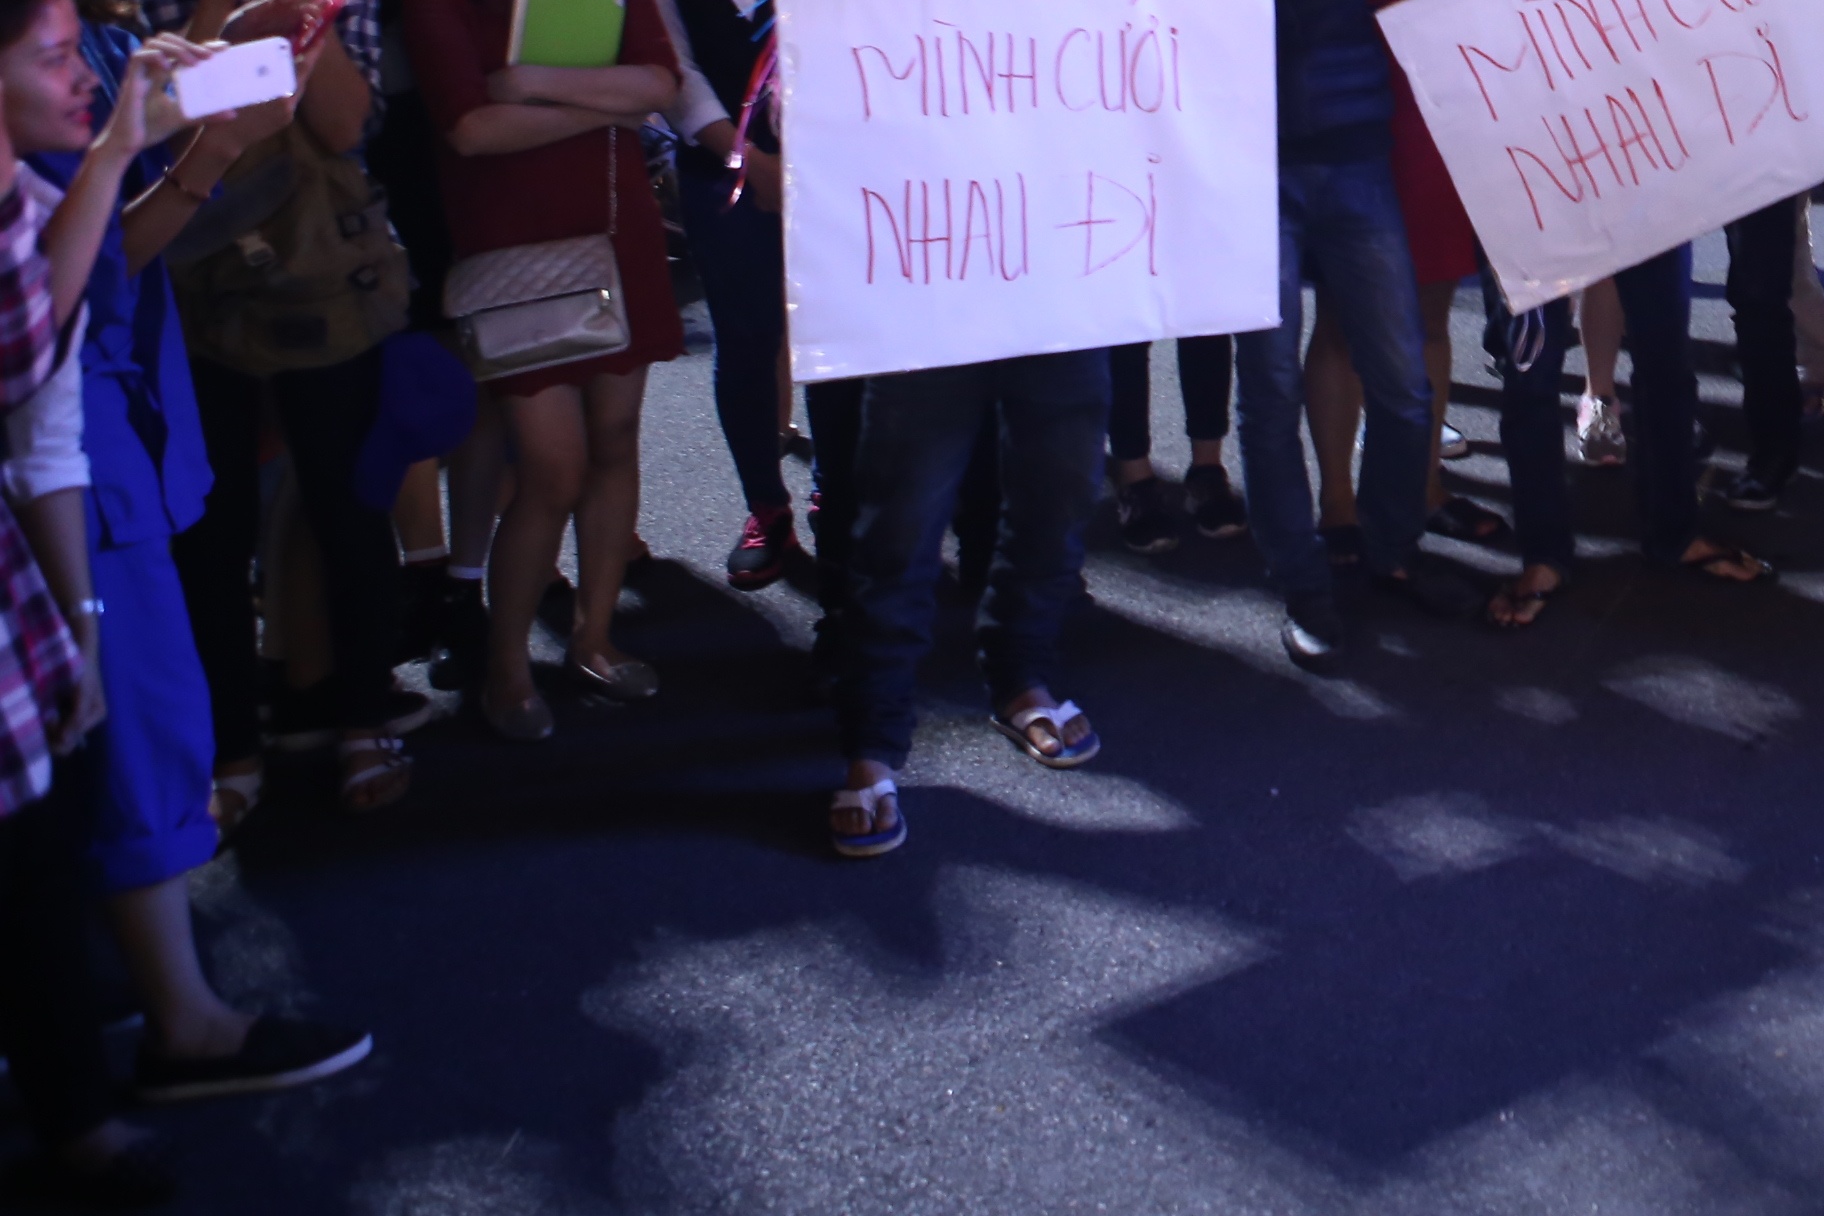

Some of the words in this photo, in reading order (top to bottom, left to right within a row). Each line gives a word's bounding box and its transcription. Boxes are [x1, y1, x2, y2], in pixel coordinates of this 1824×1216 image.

[851, 20, 1036, 121] MÌNH
[1505, 78, 1691, 232] NHAU
[862, 172, 1029, 285] NHAU
